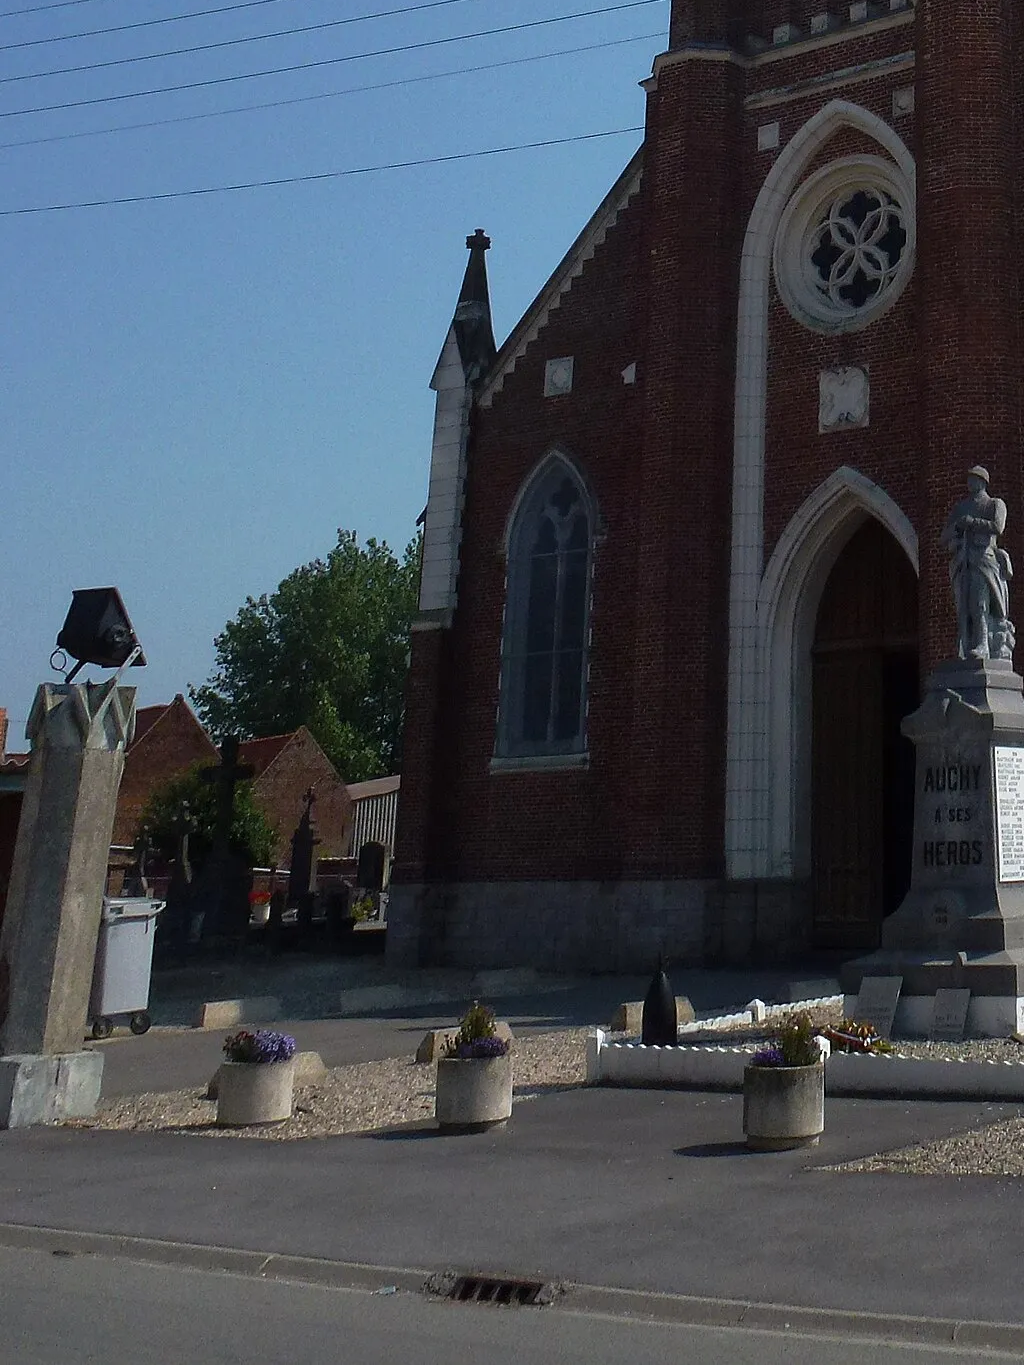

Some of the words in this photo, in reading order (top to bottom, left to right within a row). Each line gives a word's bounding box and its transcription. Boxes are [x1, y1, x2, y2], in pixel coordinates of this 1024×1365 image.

[924, 765, 981, 792] AUCHY
[948, 807, 972, 823] SES
[924, 840, 982, 866] HEROS
